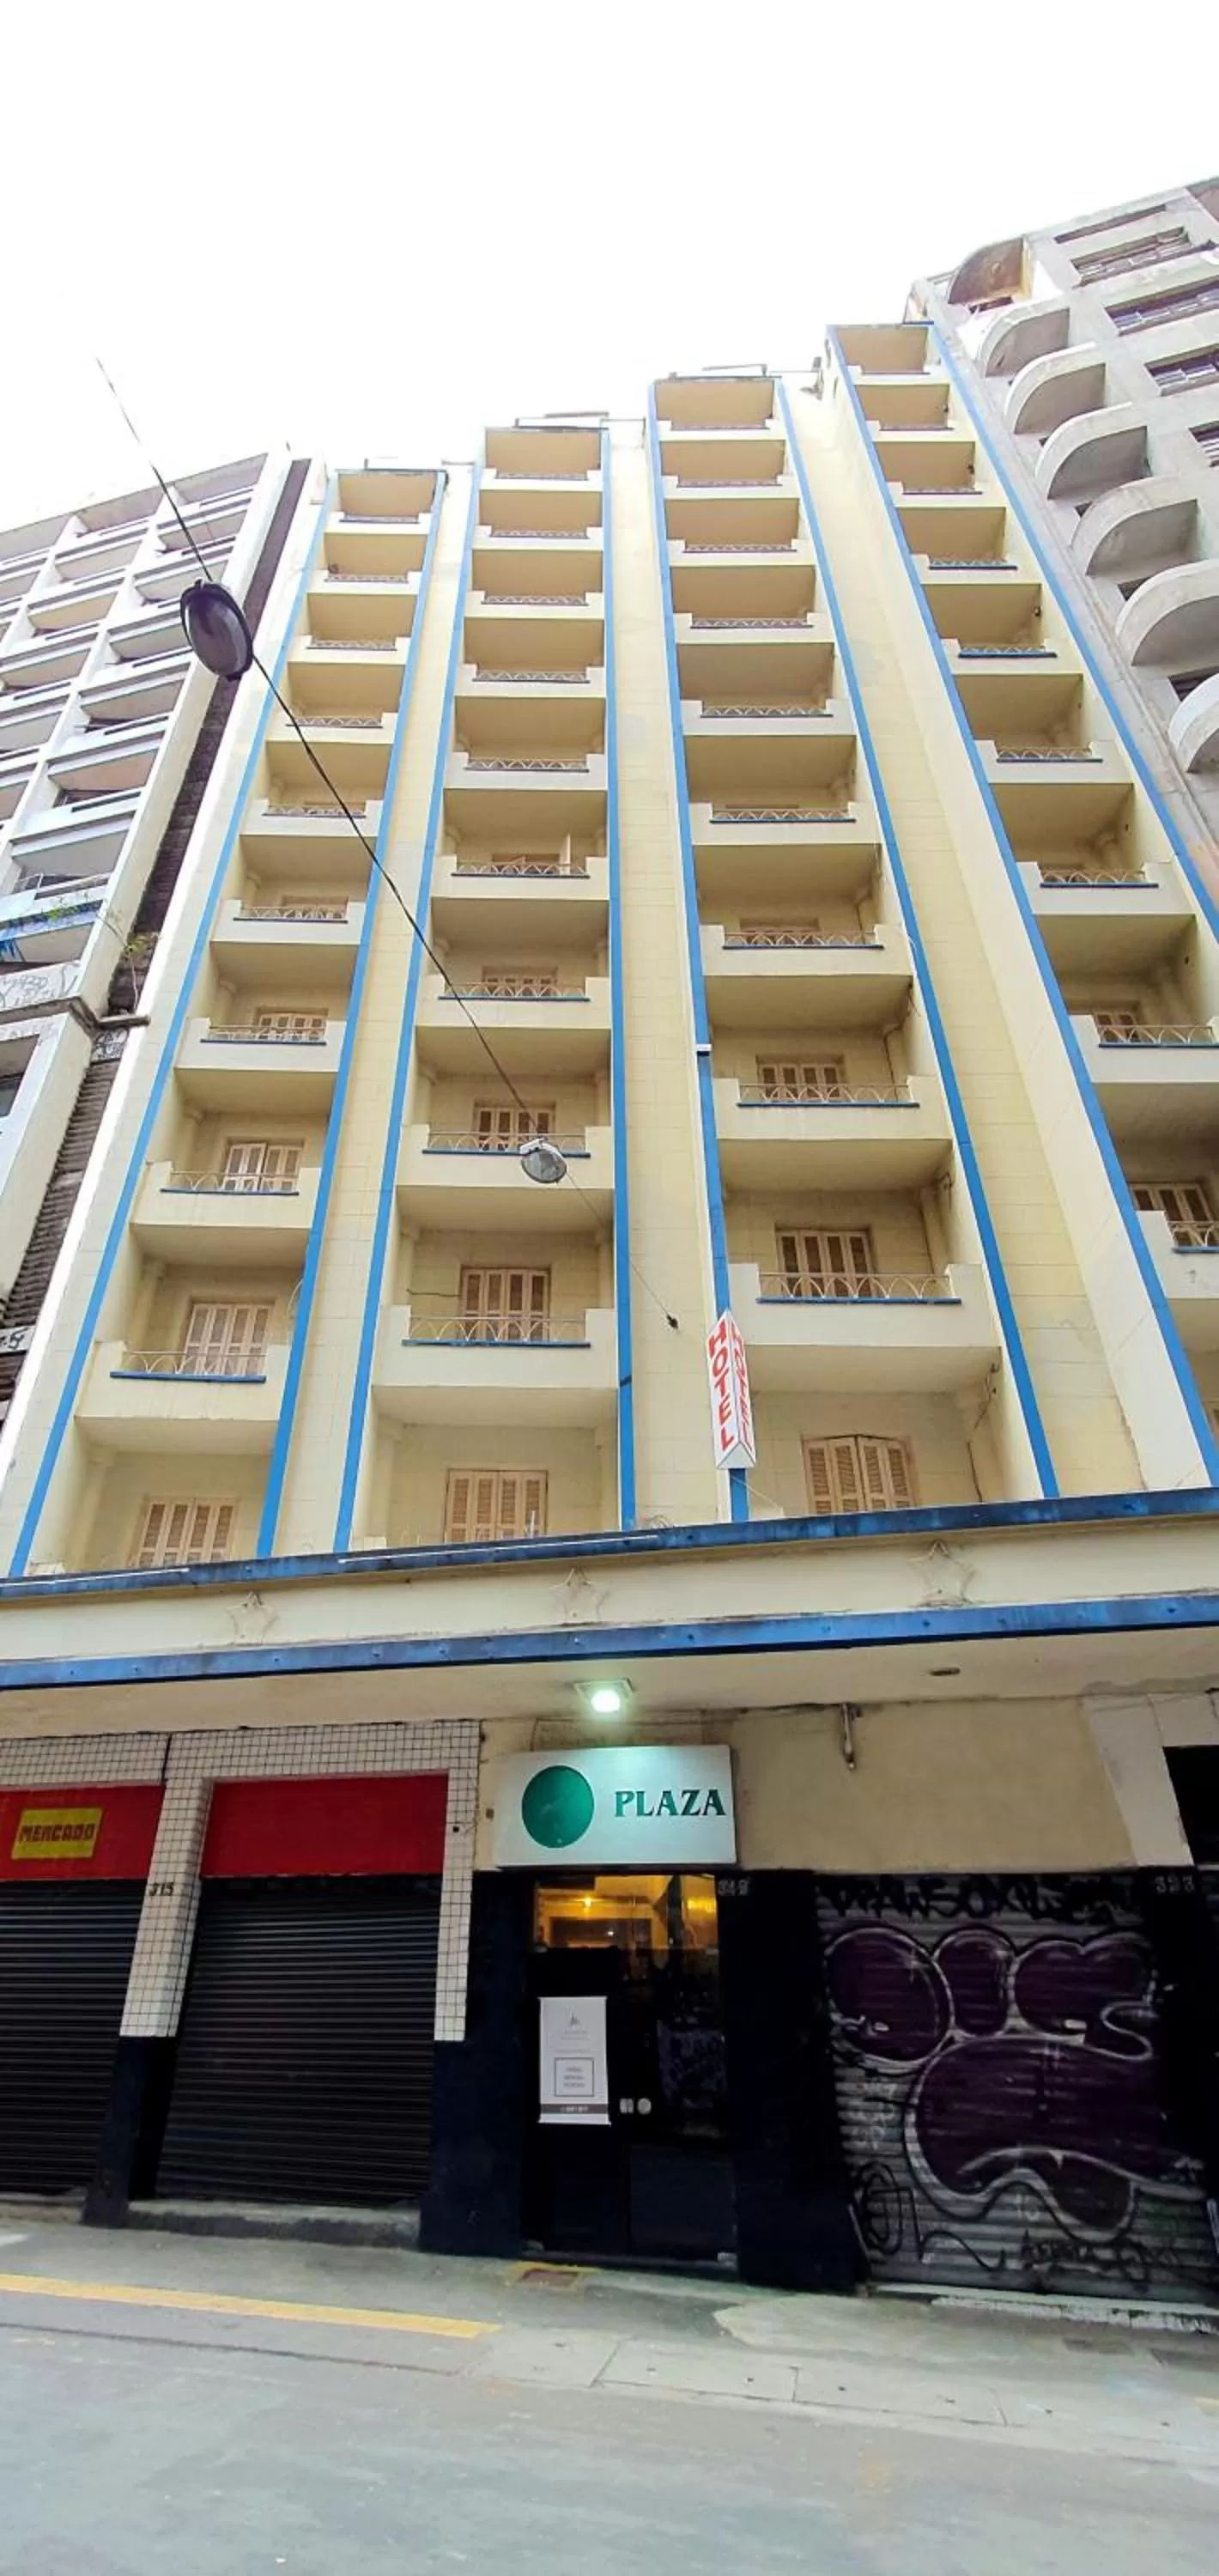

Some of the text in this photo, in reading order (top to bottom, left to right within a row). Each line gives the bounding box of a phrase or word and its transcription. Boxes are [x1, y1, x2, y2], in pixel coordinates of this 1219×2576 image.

[708, 1318, 734, 1451] HOTEL
[615, 1789, 726, 1817] PLAZA
[20, 1823, 95, 1842] MERCADO
